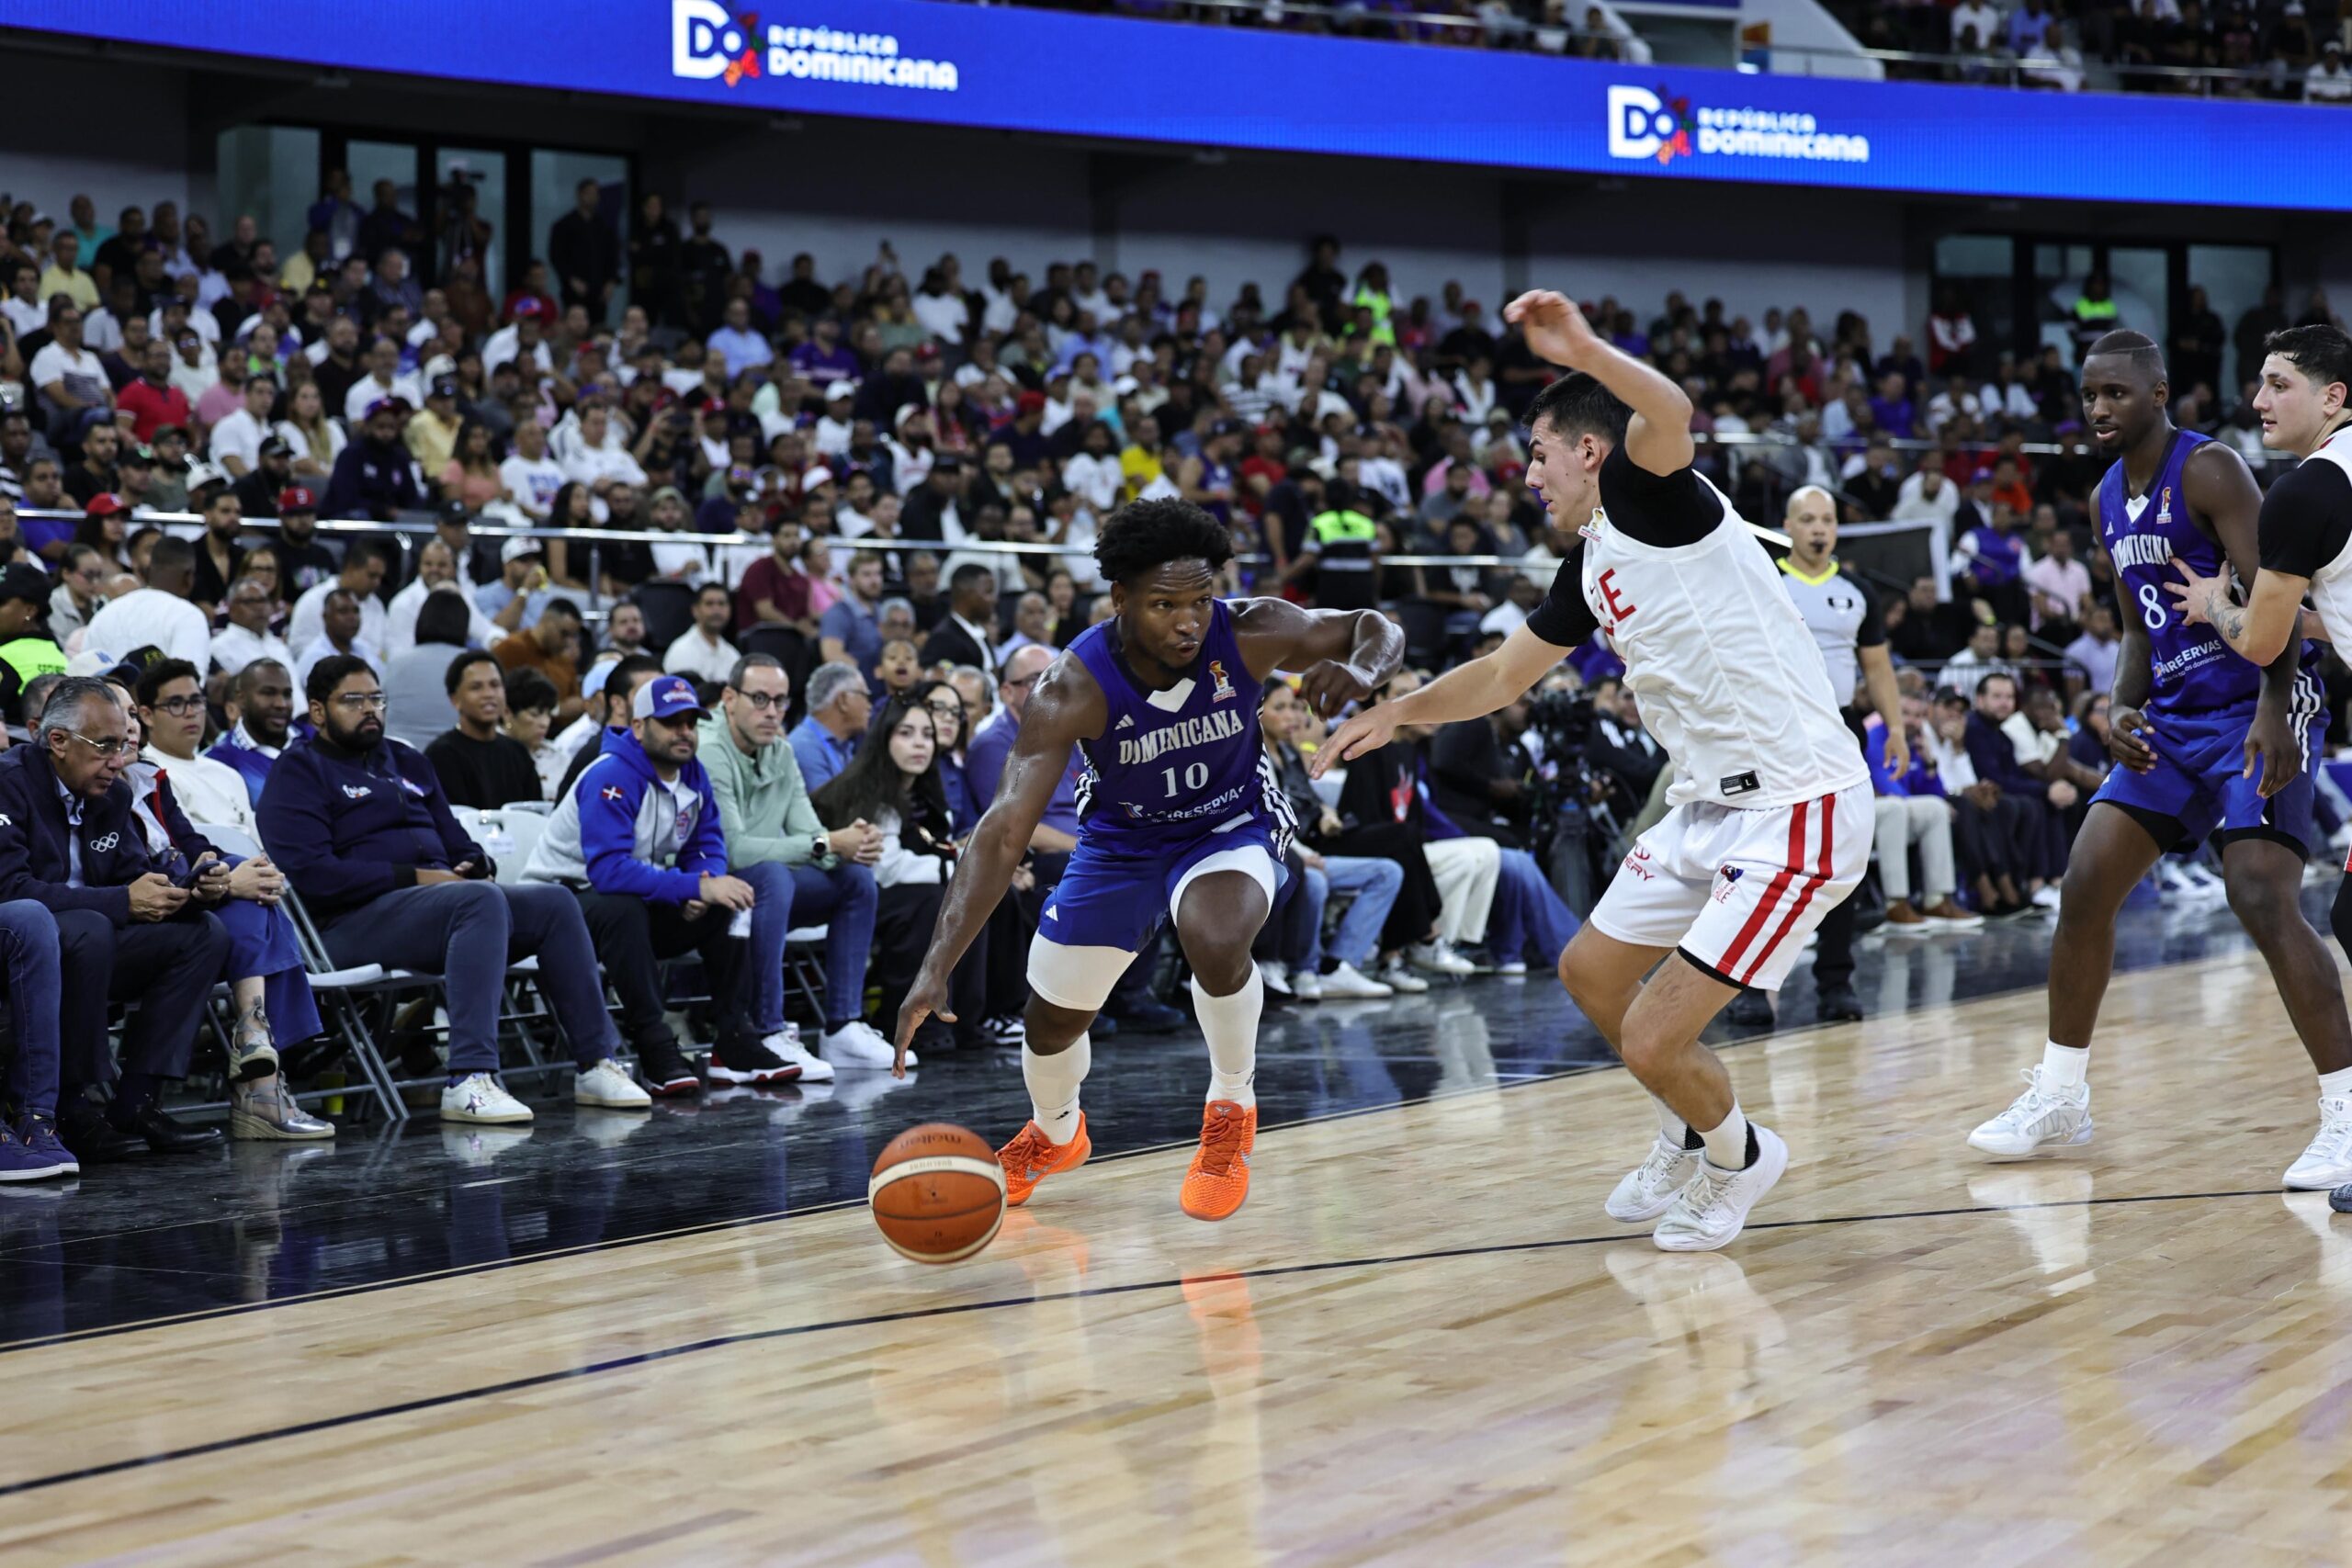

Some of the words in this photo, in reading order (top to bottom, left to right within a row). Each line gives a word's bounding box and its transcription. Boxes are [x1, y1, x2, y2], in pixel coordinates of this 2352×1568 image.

[768, 47, 958, 91] DOMINICANA
[2139, 583, 2166, 629] 8
[1160, 761, 1209, 798] 10
[1623, 855, 1656, 881] ERY
